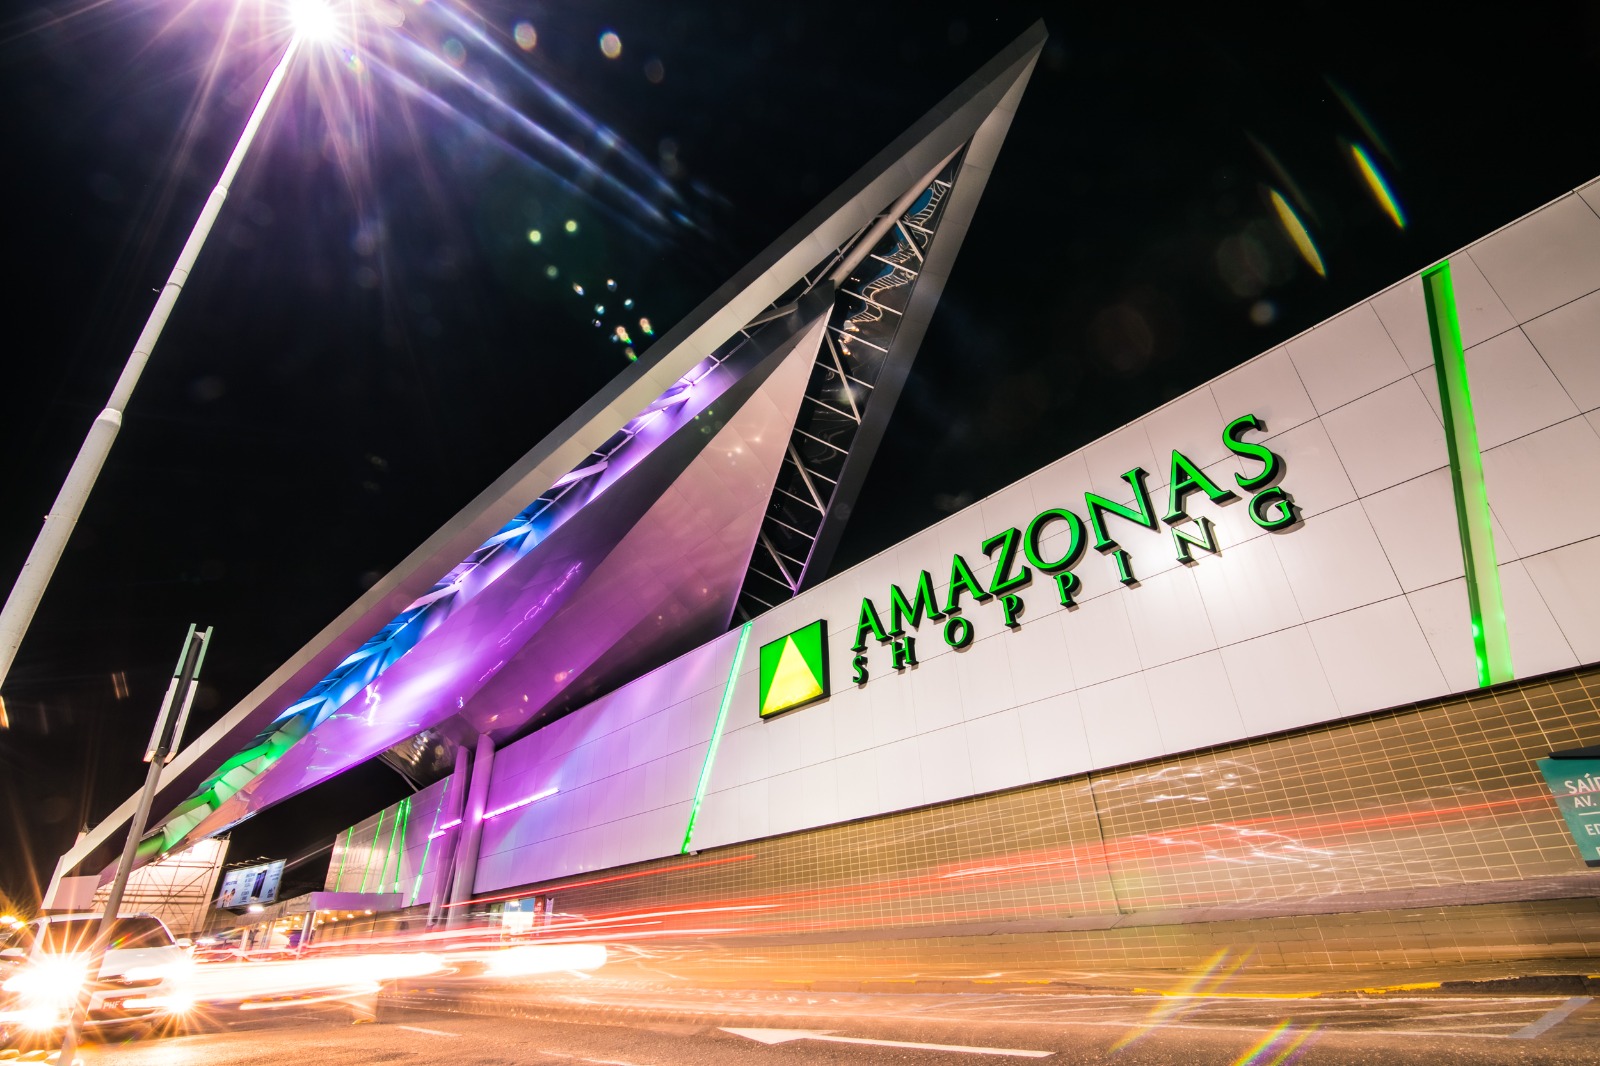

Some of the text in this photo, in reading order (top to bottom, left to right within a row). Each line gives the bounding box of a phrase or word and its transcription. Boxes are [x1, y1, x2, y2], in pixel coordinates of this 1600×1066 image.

[850, 413, 1279, 652] AMAZONAS
[852, 486, 1297, 685] SHOPPING
[1574, 795, 1597, 808] AV.
